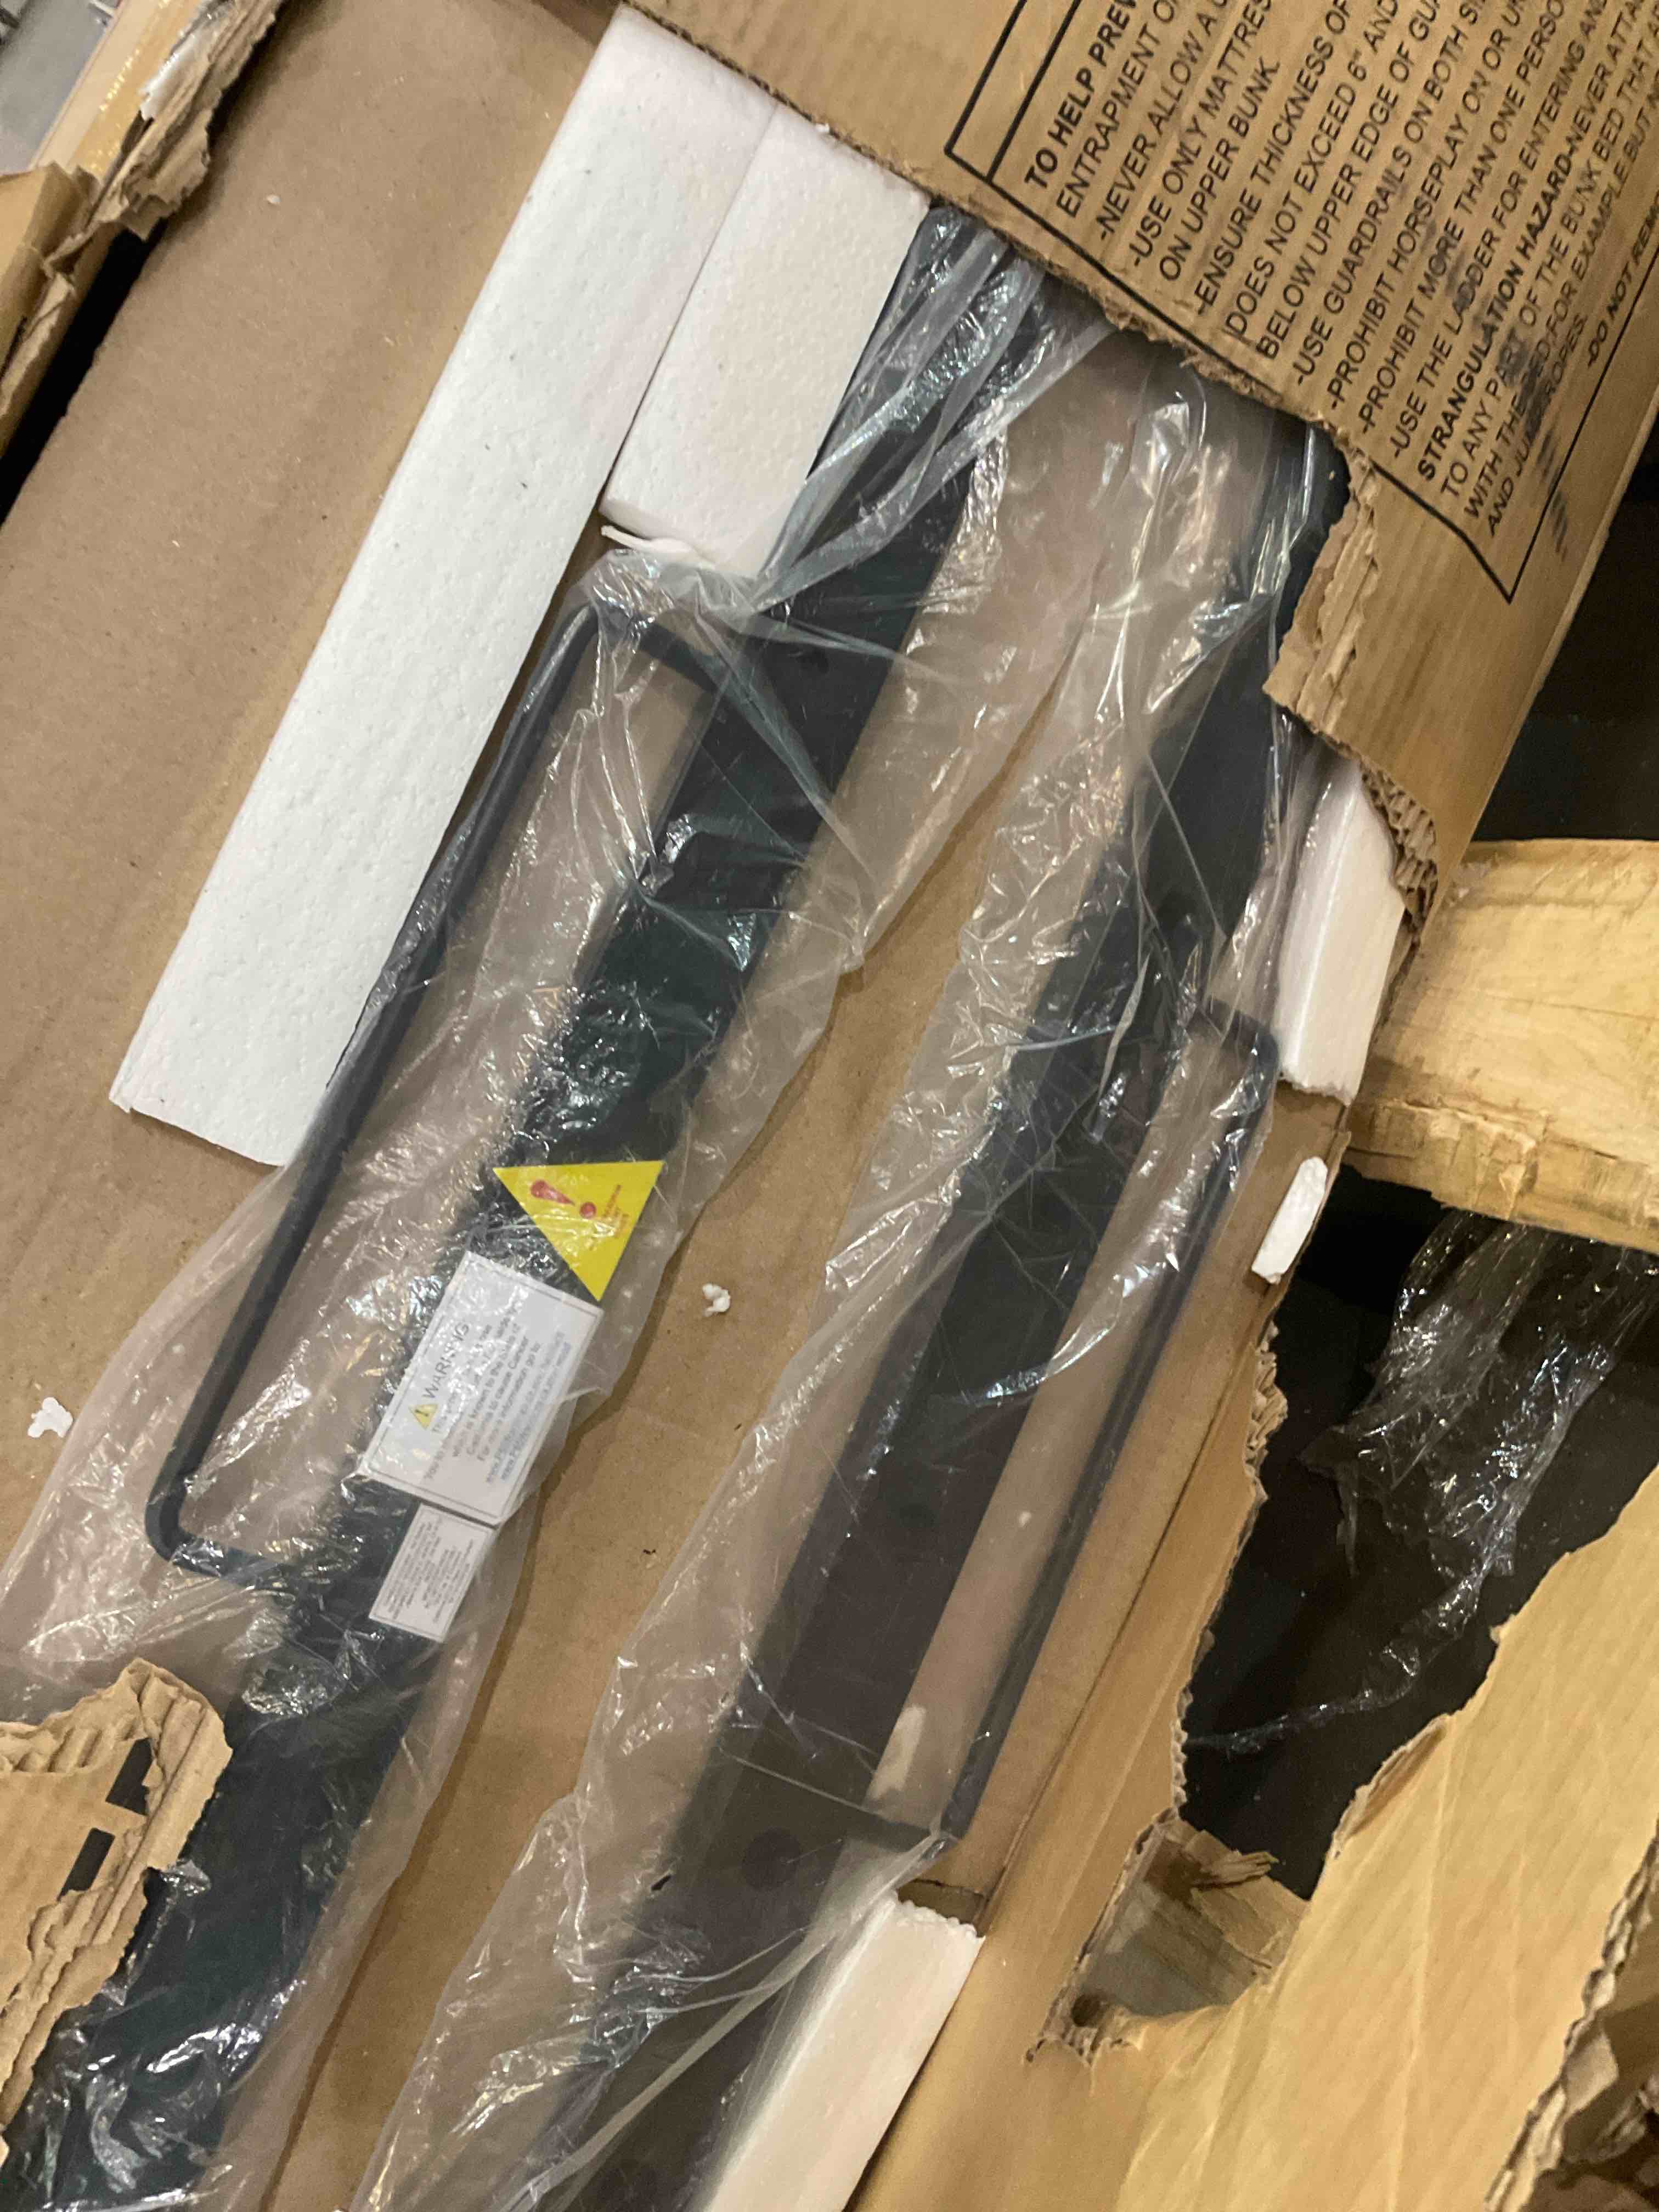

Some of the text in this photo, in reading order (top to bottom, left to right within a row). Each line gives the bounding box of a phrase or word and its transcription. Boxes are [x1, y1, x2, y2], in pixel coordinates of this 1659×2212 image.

[1023, 147, 1058, 189] TO
[1047, 66, 1095, 149] HELP
[1055, 0, 1180, 219] ENTRAPMENT O
[1094, 12, 1218, 241] -NEVER ALLOW A
[1128, 194, 1172, 268] -USE
[1161, 114, 1207, 195] ONLY
[1159, 234, 1193, 282] ON
[1180, 137, 1240, 235] UPPER
[1183, 0, 1351, 317] -ENSURE THICKNESS OF
[1223, 0, 1399, 337] DOES NOT EXCEED 6" AND
[1252, 0, 1441, 361] BELOW UPPER EDGE OF GU
[1292, 315, 1334, 386] -USE
[1323, 145, 1413, 315] GUARDRAILS
[1403, 99, 1434, 144] ON
[1422, 24, 1469, 103] BOTH
[1327, 270, 1395, 410] -PROHIBIT
[1386, 112, 1469, 275] HORSEPLAY
[1462, 70, 1491, 115] ON
[1481, 28, 1513, 71] OR
[1358, 297, 1425, 435] -PROHIBIT
[1417, 217, 1464, 301] MORE
[1453, 143, 1498, 215] THAN
[1489, 83, 1526, 145] ONE
[1389, 390, 1427, 459] -USE
[1415, 333, 1453, 388] THE
[1442, 228, 1501, 336] LADDER
[1491, 170, 1528, 230] FOR
[1518, 39, 1585, 172] ENTERING
[1417, 259, 1525, 482] STRANGULATION
[1515, 62, 1613, 261] HAZARD-NEVER
[1439, 459, 1469, 499] TO
[1460, 397, 1493, 462] ANY
[1484, 325, 1527, 403] PART
[1517, 286, 1542, 329] OF
[1534, 232, 1570, 287] THE
[1559, 158, 1602, 236] BUNK
[1592, 107, 1625, 163] BED
[1615, 36, 1659, 106] THAT
[1605, 261, 1632, 319] NOT
[1633, 189, 1659, 264] REM
[1463, 449, 1503, 520] WITH
[1495, 392, 1534, 447] THE
[1570, 160, 1630, 282] EXAMPLE
[1622, 106, 1651, 165] BUT
[1646, 69, 1659, 110] N
[1486, 476, 1515, 539] AND
[1513, 392, 1548, 477] JU
